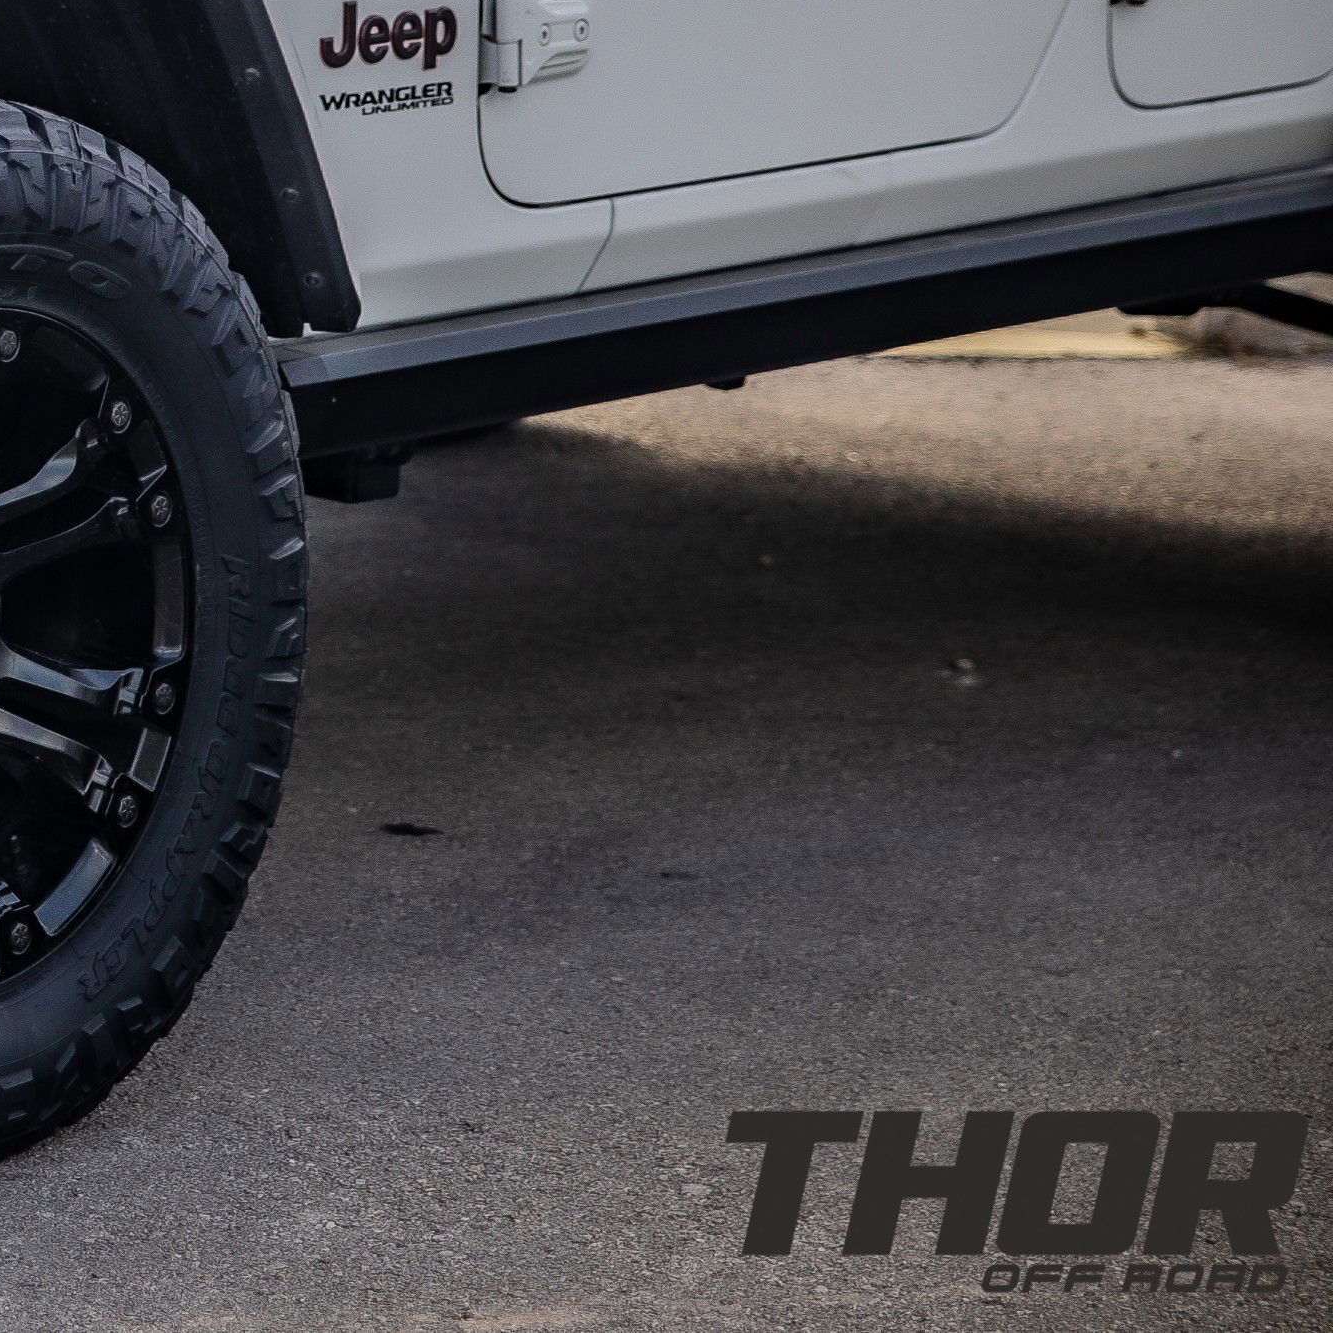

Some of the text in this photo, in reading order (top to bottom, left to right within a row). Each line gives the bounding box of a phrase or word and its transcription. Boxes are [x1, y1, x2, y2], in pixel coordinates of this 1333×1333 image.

[319, 1, 457, 70] Jeep
[319, 81, 453, 111] WRANGLER
[361, 96, 454, 116] UNLIMITED
